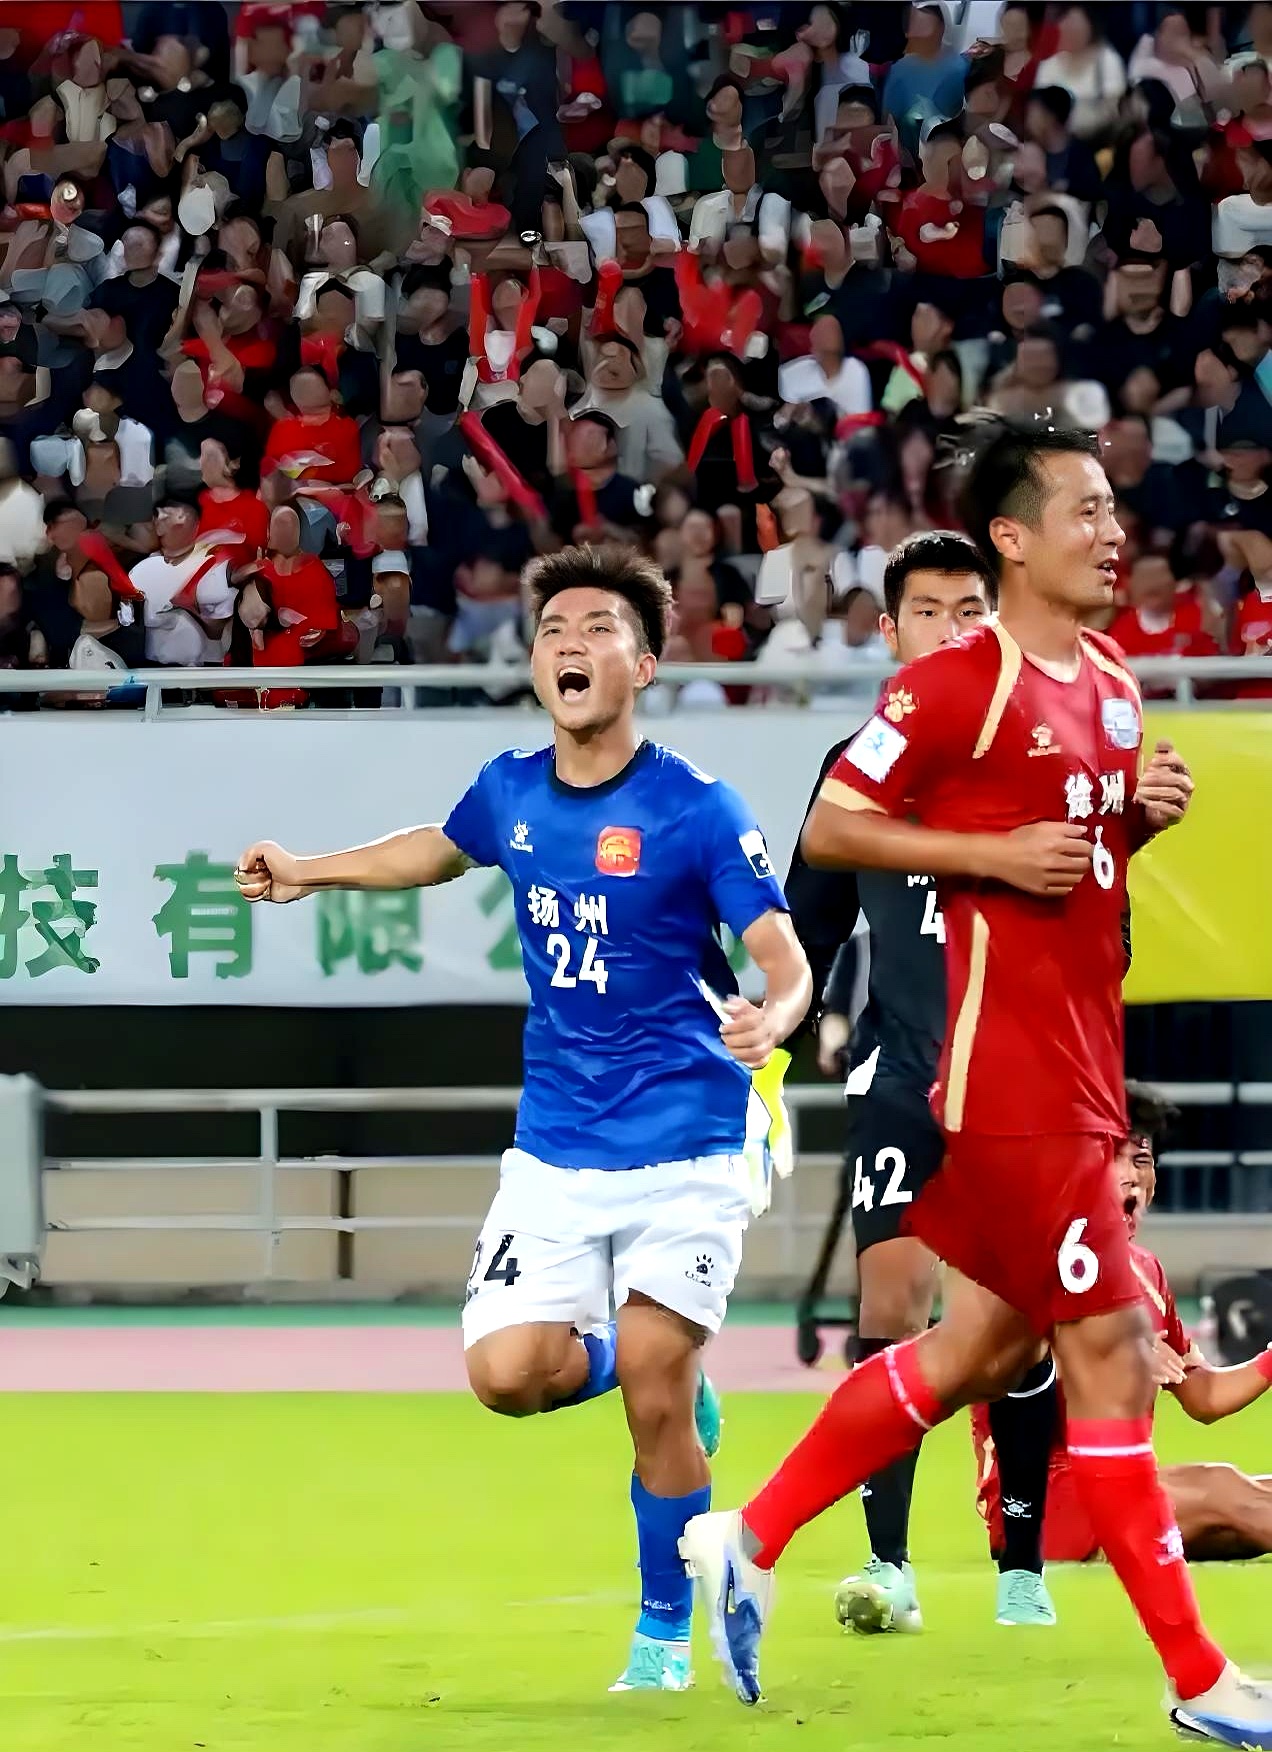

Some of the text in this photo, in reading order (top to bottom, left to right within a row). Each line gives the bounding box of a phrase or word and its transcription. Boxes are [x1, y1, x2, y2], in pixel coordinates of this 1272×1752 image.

[1093, 825, 1114, 890] 6
[528, 884, 608, 935] 扬州
[547, 934, 609, 994] 24
[852, 1147, 913, 1212] 42
[1058, 1217, 1099, 1294] 6
